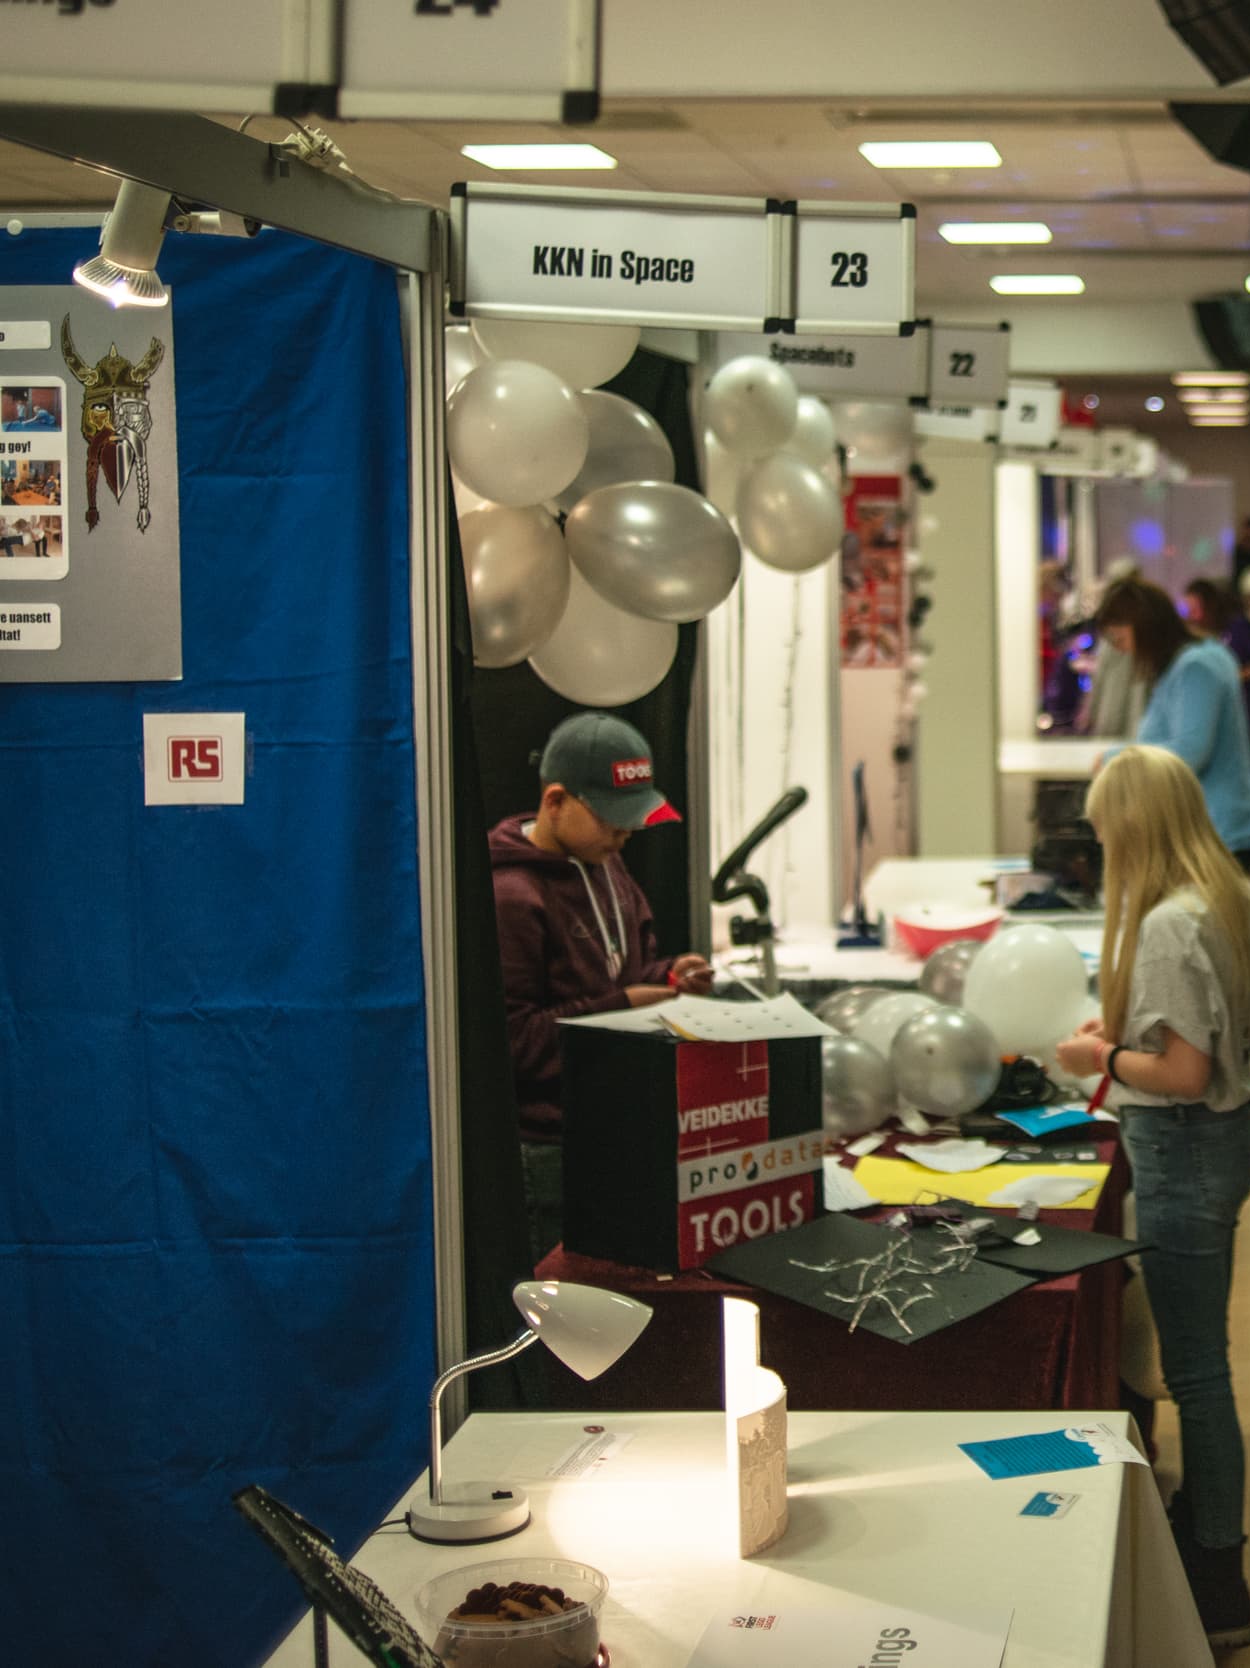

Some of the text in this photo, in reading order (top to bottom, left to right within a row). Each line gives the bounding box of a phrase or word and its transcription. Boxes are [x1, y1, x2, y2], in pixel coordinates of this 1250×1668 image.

[533, 245, 694, 285] KKN in Space
[830, 252, 868, 288] 23
[949, 352, 975, 377] 22
[8, 440, 31, 454] gøy!
[9, 612, 52, 624] uansett
[171, 740, 219, 778] RS
[679, 1096, 769, 1135] VEIDEKKE
[689, 1164, 737, 1193] pro
[690, 1191, 805, 1252] TOOLS
